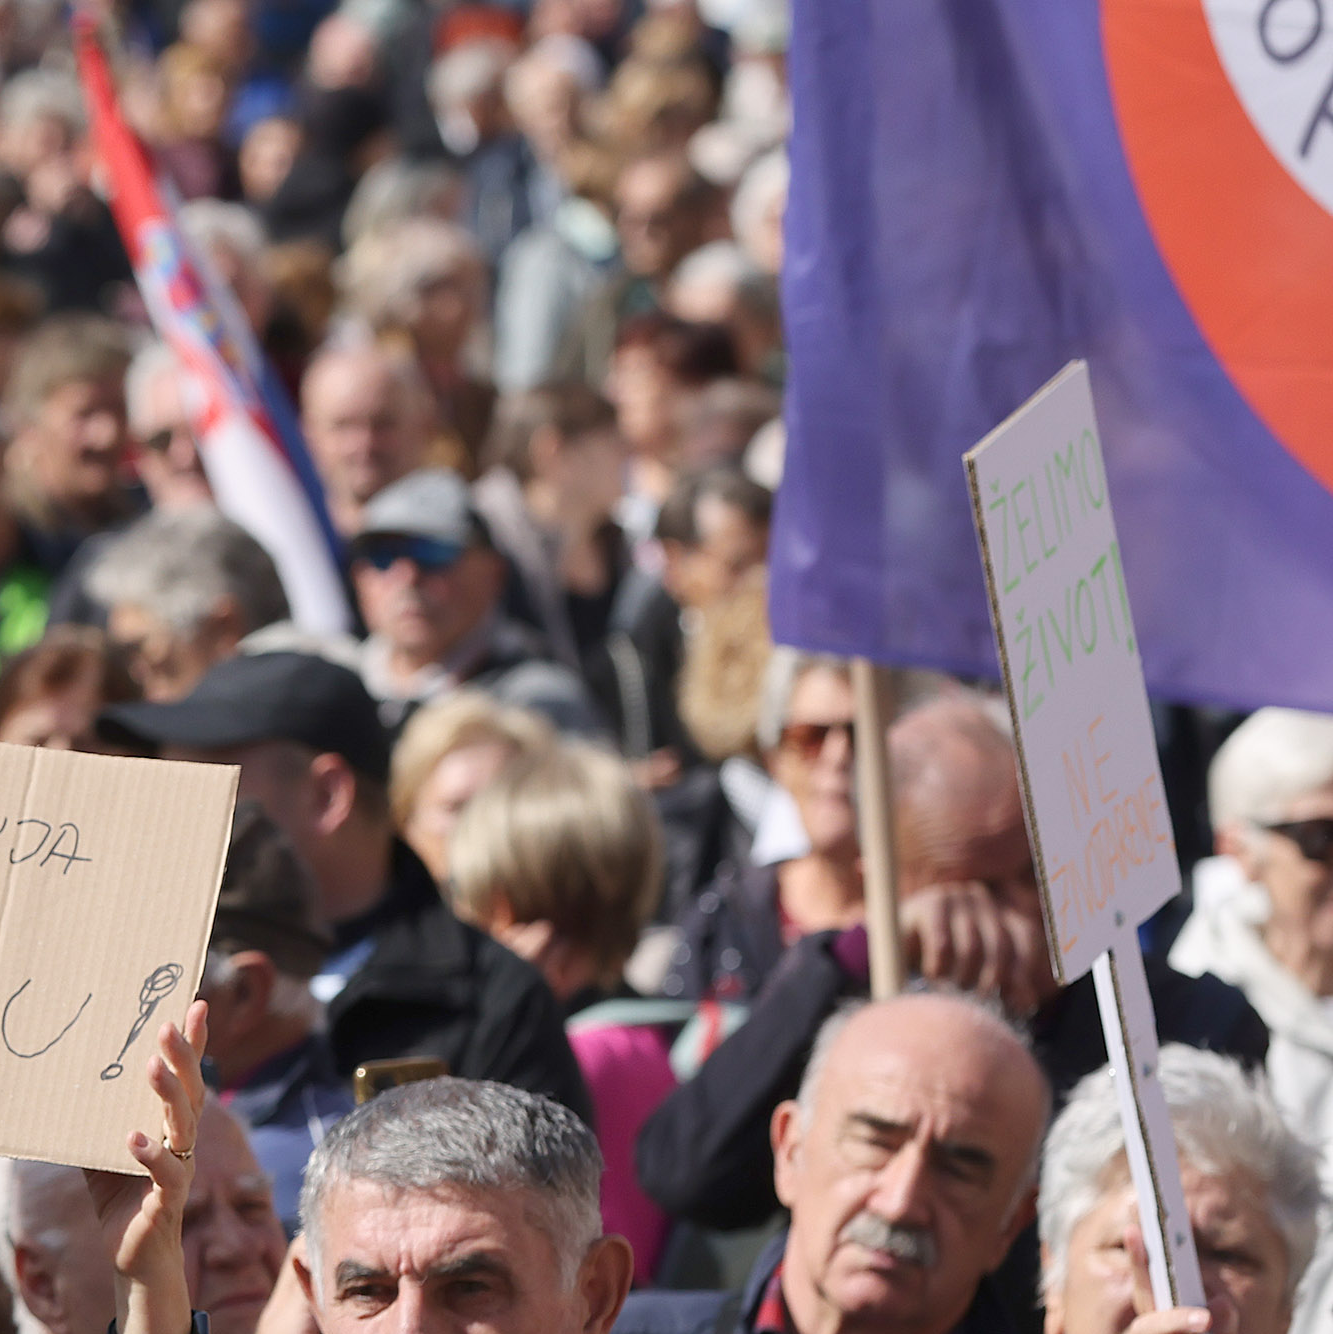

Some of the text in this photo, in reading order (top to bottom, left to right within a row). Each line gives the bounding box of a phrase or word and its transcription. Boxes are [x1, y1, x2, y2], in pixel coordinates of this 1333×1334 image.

[988, 428, 1105, 595] ŽELIMO
[1014, 542, 1135, 722] ŽIVOT!
[1062, 713, 1118, 831] NE
